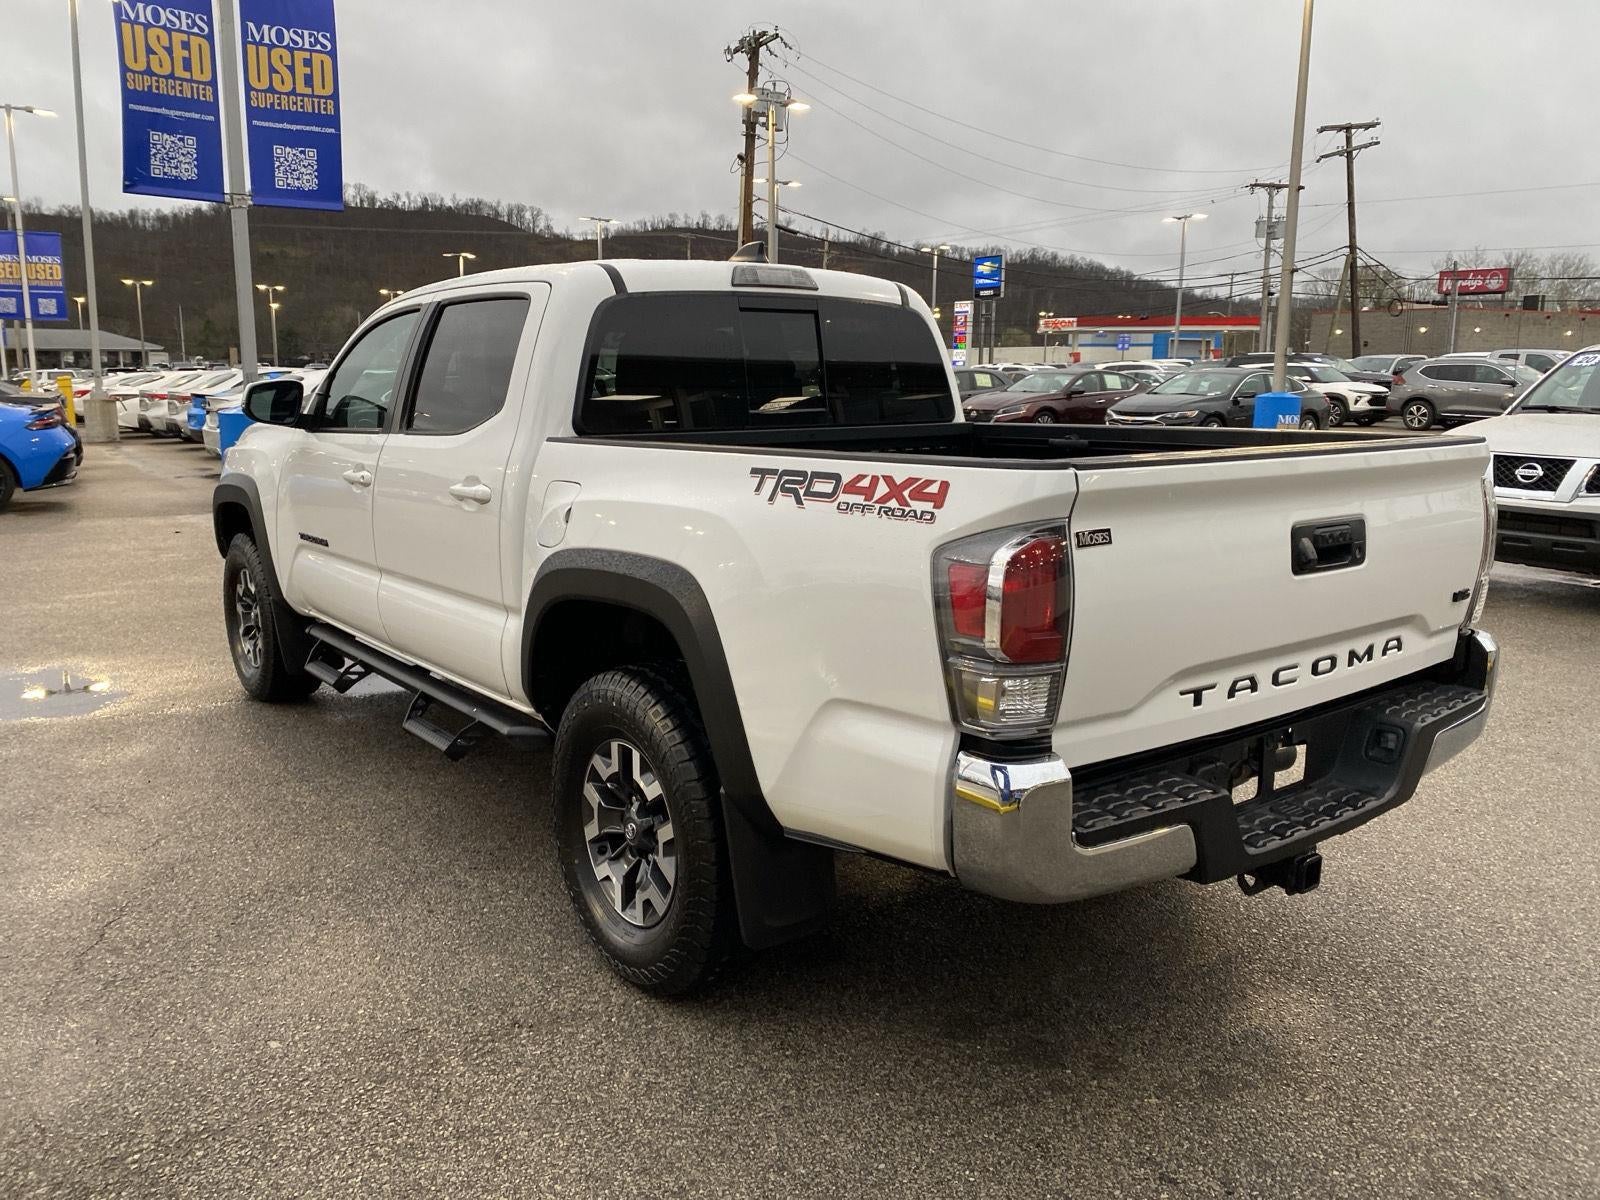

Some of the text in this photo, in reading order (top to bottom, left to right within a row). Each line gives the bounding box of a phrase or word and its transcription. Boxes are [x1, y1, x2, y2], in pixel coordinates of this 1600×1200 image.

[120, 0, 209, 35] MOSES
[246, 21, 332, 52] MOSES
[121, 22, 212, 82] USED
[246, 44, 334, 96] USED
[126, 72, 214, 102] SUPERCENTER
[250, 91, 335, 115] SUPERCENTER
[252, 120, 335, 134] mosesusedsupercenter.com
[26, 255, 62, 264] MOSES
[27, 263, 62, 280] USED
[1442, 272, 1484, 292] Wndy's
[750, 467, 842, 509] TRD
[836, 501, 937, 524] OFF ROAD
[1078, 531, 1110, 546] MOSES
[1179, 634, 1404, 708] TACOMA
